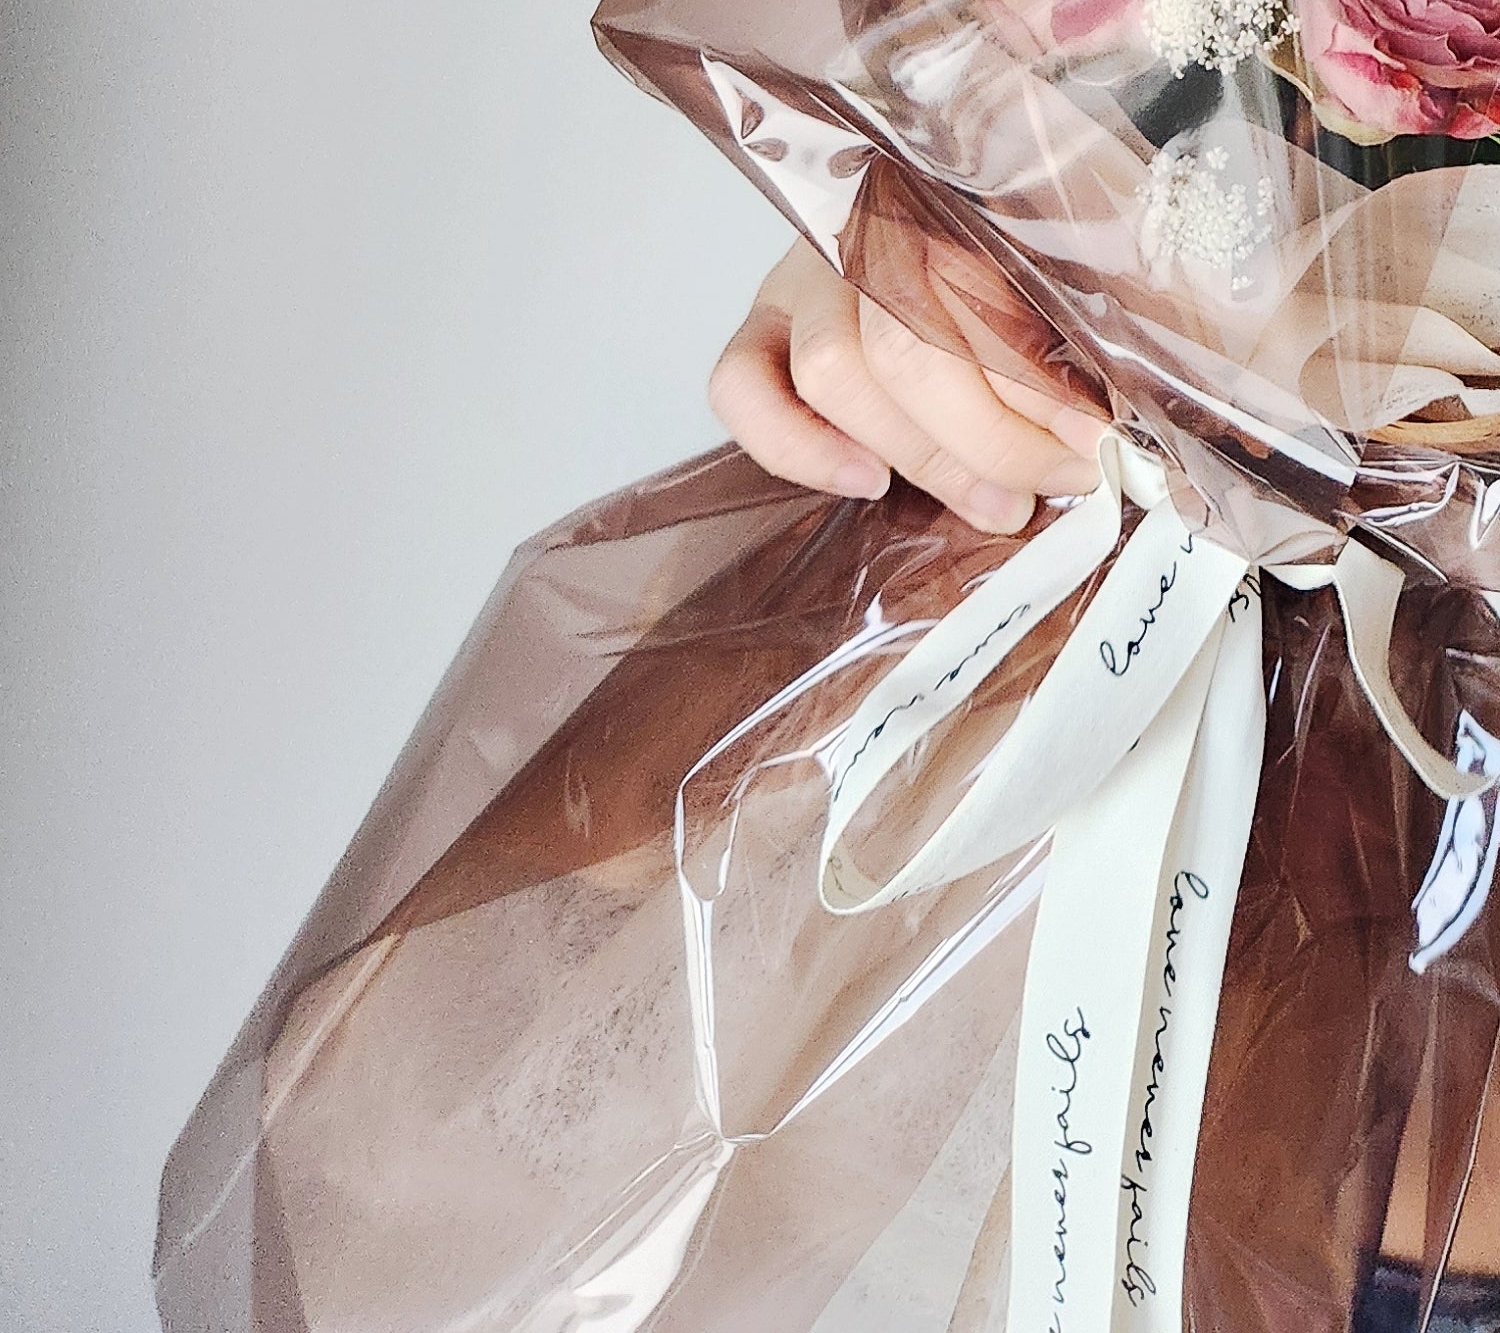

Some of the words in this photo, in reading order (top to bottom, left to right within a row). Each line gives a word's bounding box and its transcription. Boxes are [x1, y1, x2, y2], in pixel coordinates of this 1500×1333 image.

[1099, 560, 1177, 677] love
[1163, 870, 1210, 998] love
[1046, 1006, 1092, 1155] fails
[1135, 1006, 1172, 1173] never
[1051, 1157, 1069, 1304] never
